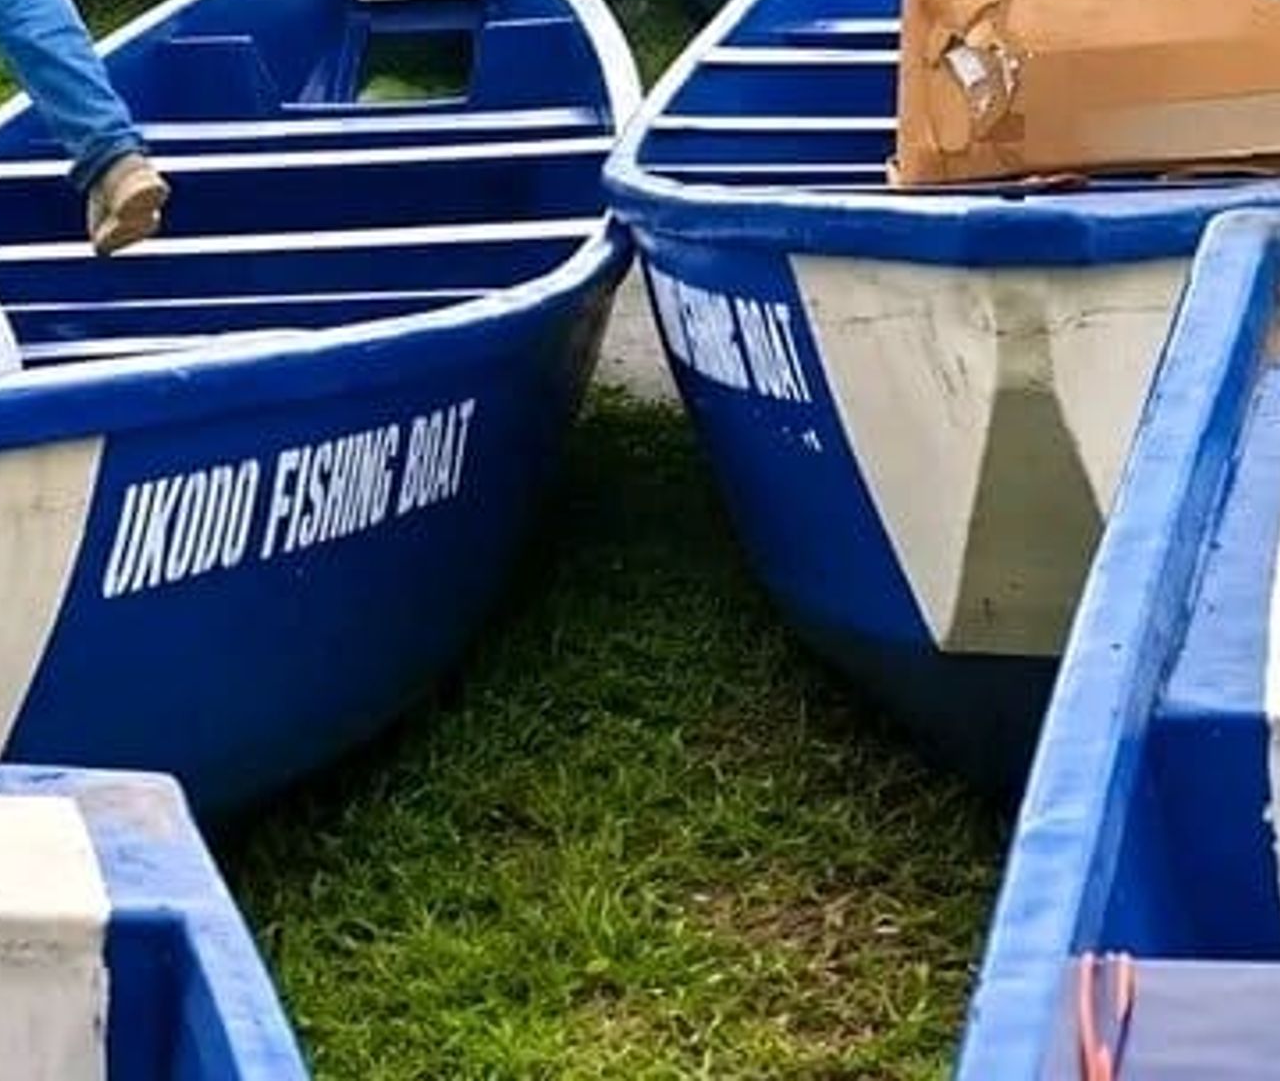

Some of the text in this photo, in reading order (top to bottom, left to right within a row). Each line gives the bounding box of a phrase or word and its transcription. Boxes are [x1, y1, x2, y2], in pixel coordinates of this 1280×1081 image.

[102, 397, 476, 600] UKODO FISHING BOAT
